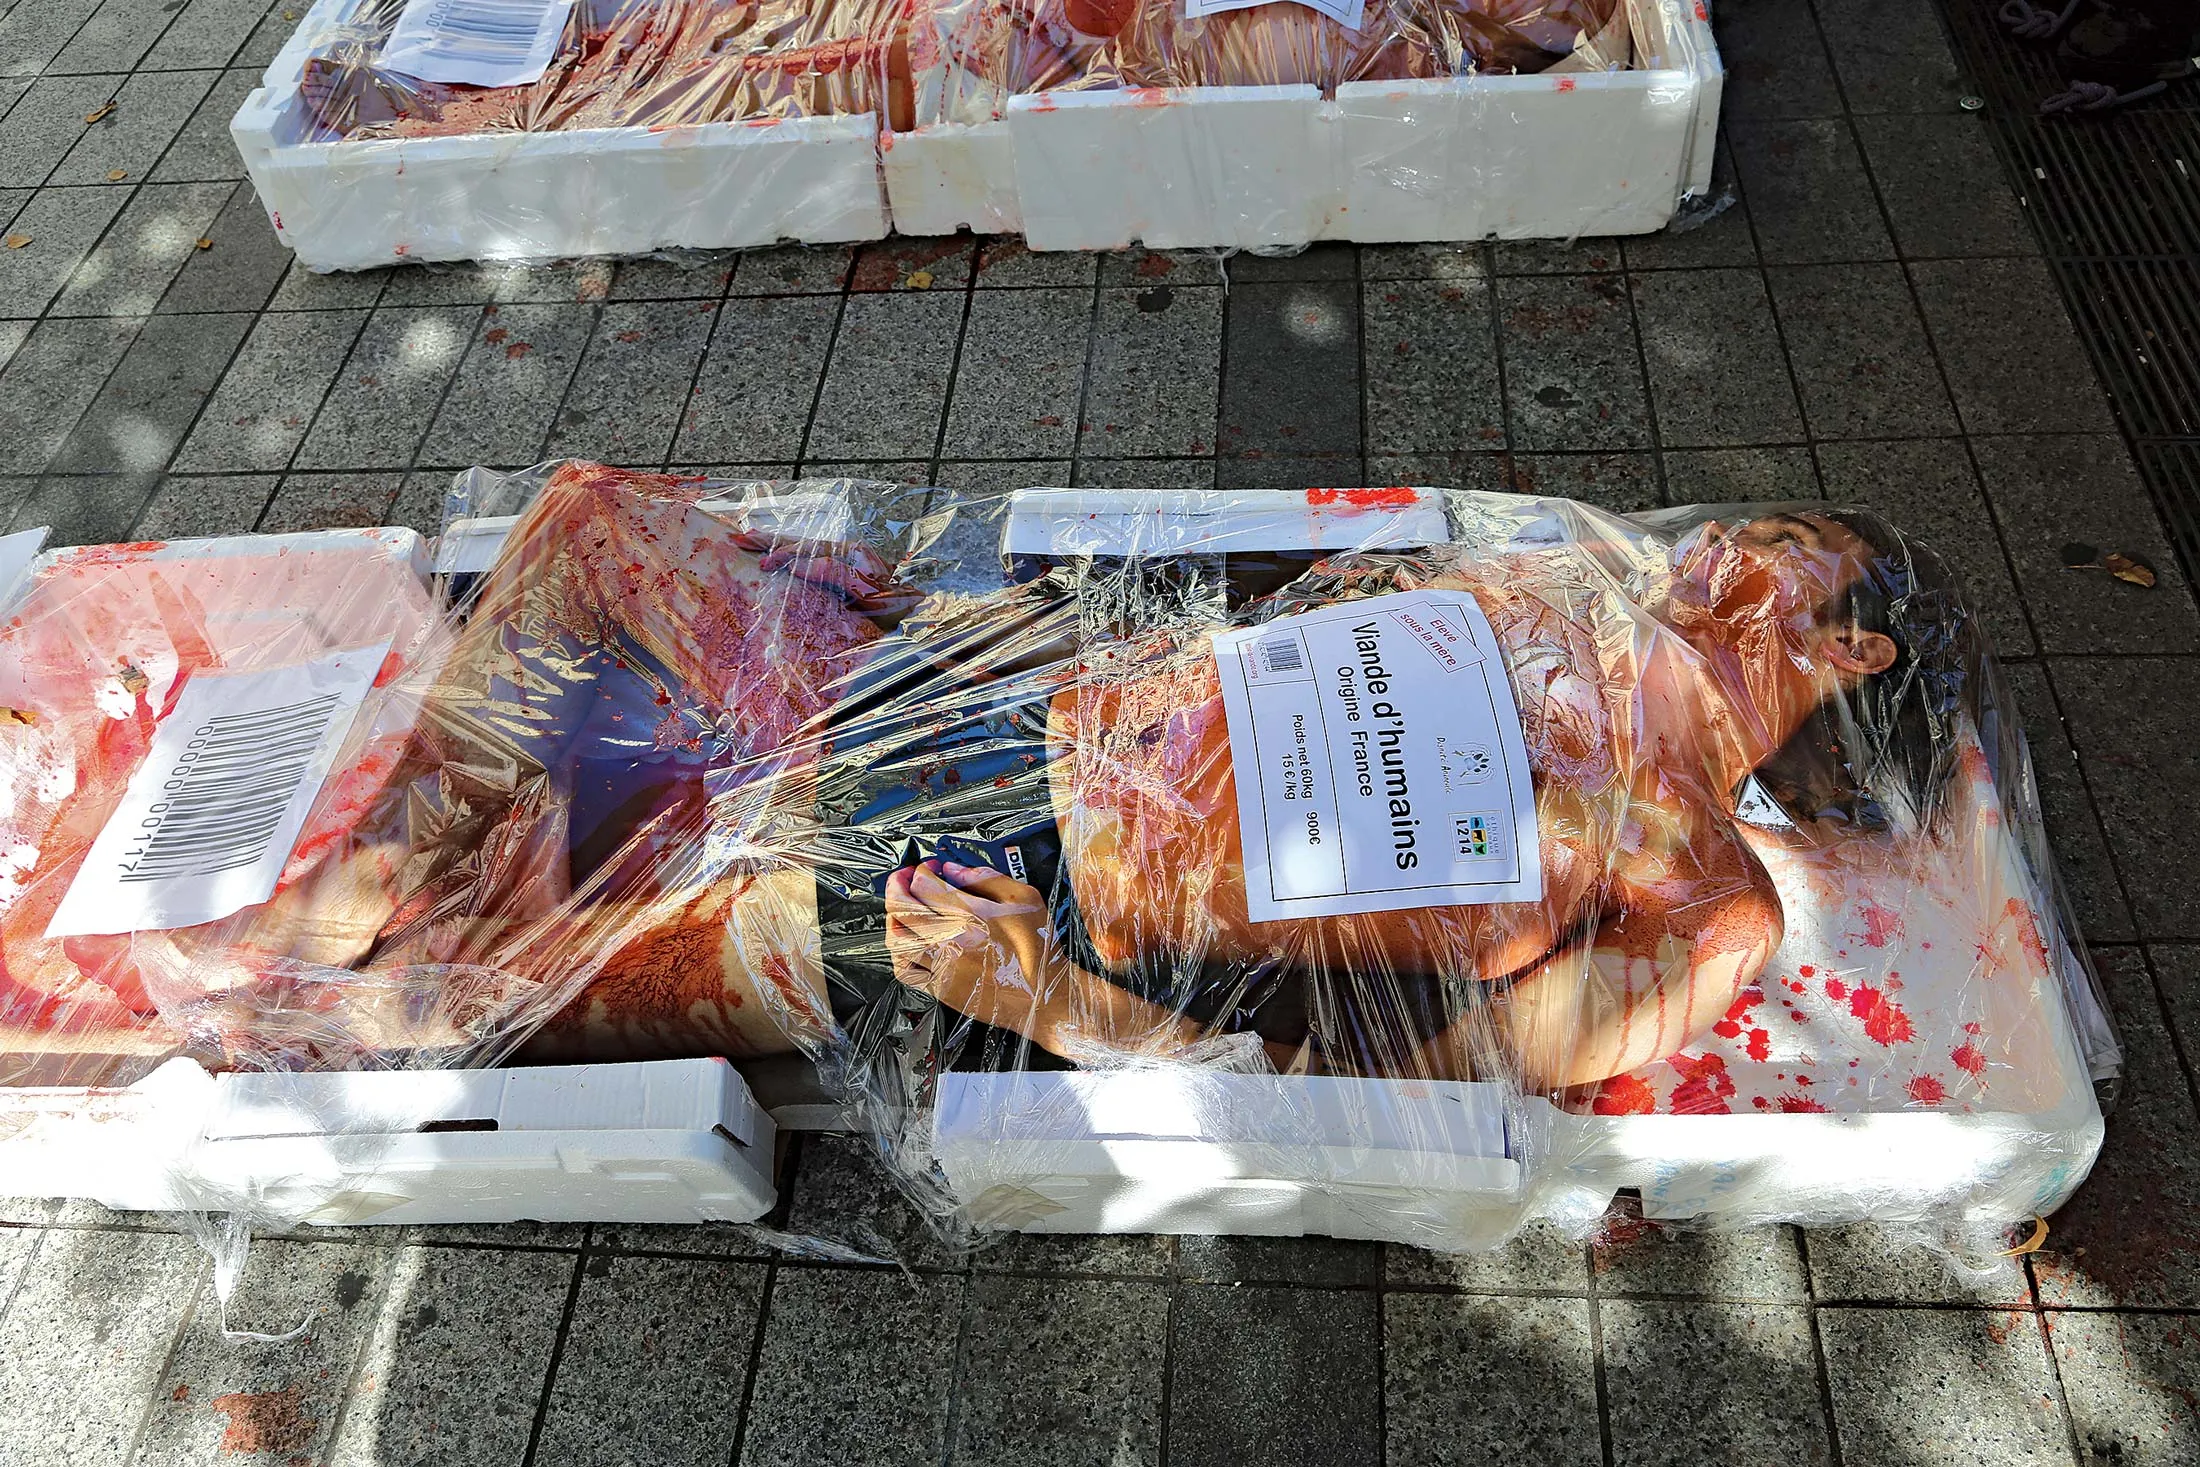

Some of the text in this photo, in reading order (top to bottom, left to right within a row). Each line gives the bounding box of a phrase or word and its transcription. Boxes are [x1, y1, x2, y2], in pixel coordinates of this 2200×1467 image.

[1400, 613, 1457, 666] sous la mère
[1430, 619, 1459, 643] Elevé
[1351, 621, 1392, 695] Viande
[1337, 666, 1373, 797] Origine France
[1292, 714, 1321, 845] Poids net 60kg 900€
[1455, 819, 1472, 855] L214
[1009, 851, 1025, 880] DIM
